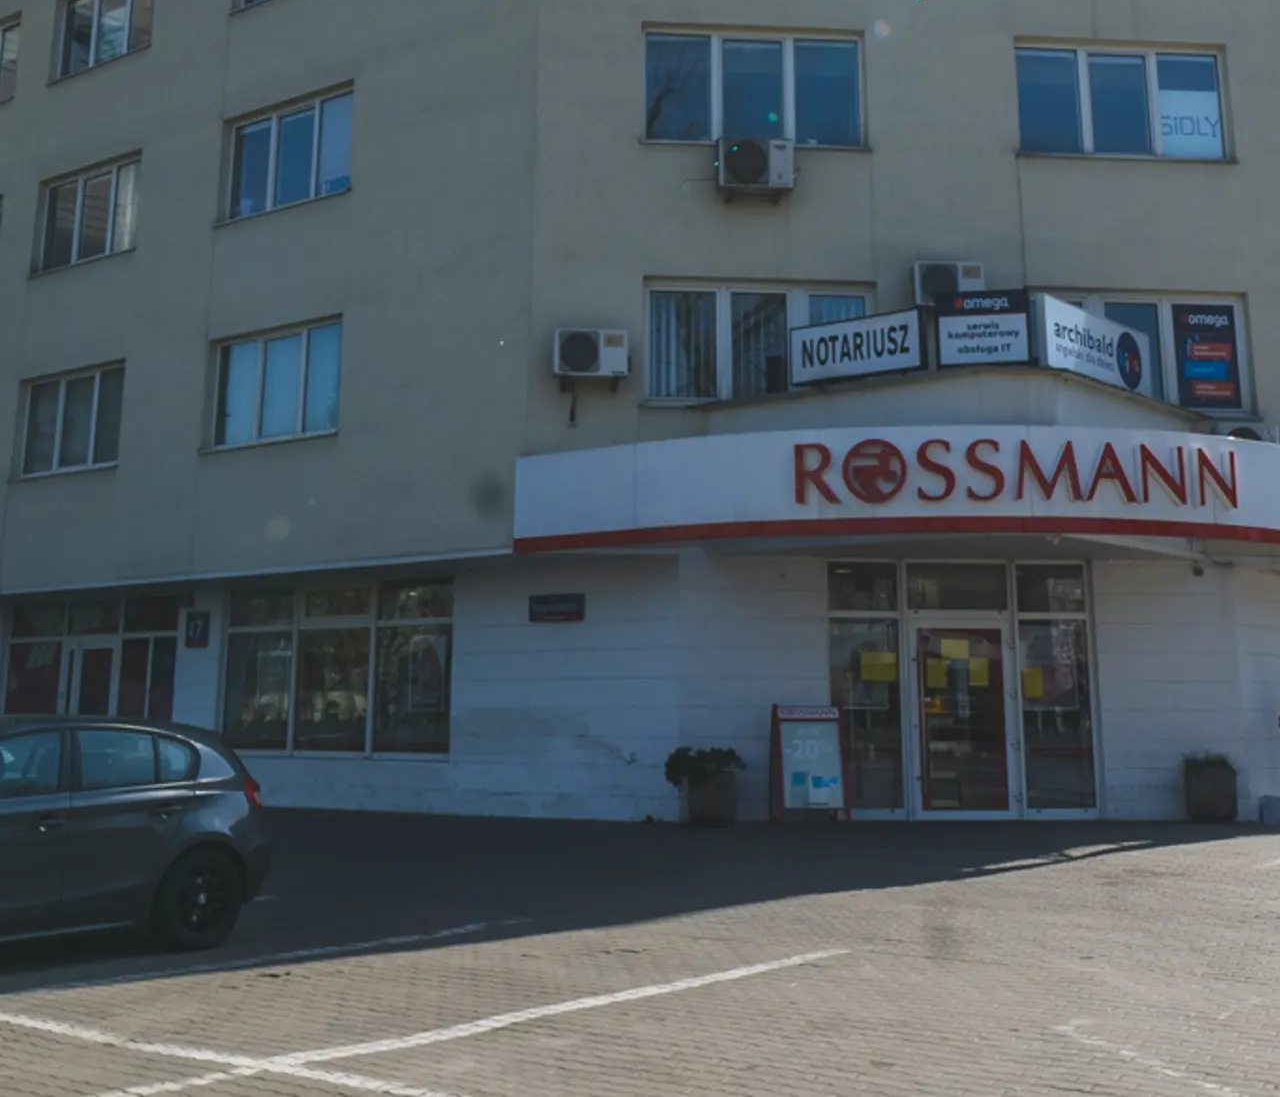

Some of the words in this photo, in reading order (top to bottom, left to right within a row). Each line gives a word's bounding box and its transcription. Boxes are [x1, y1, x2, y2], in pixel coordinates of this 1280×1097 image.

[964, 296, 1010, 311] omega
[966, 320, 1001, 331] serwis
[1188, 313, 1229, 328] omega
[801, 324, 910, 368] NOTARIUSZ
[1053, 321, 1115, 358] archibald
[793, 438, 1238, 510] ROSSMANN
